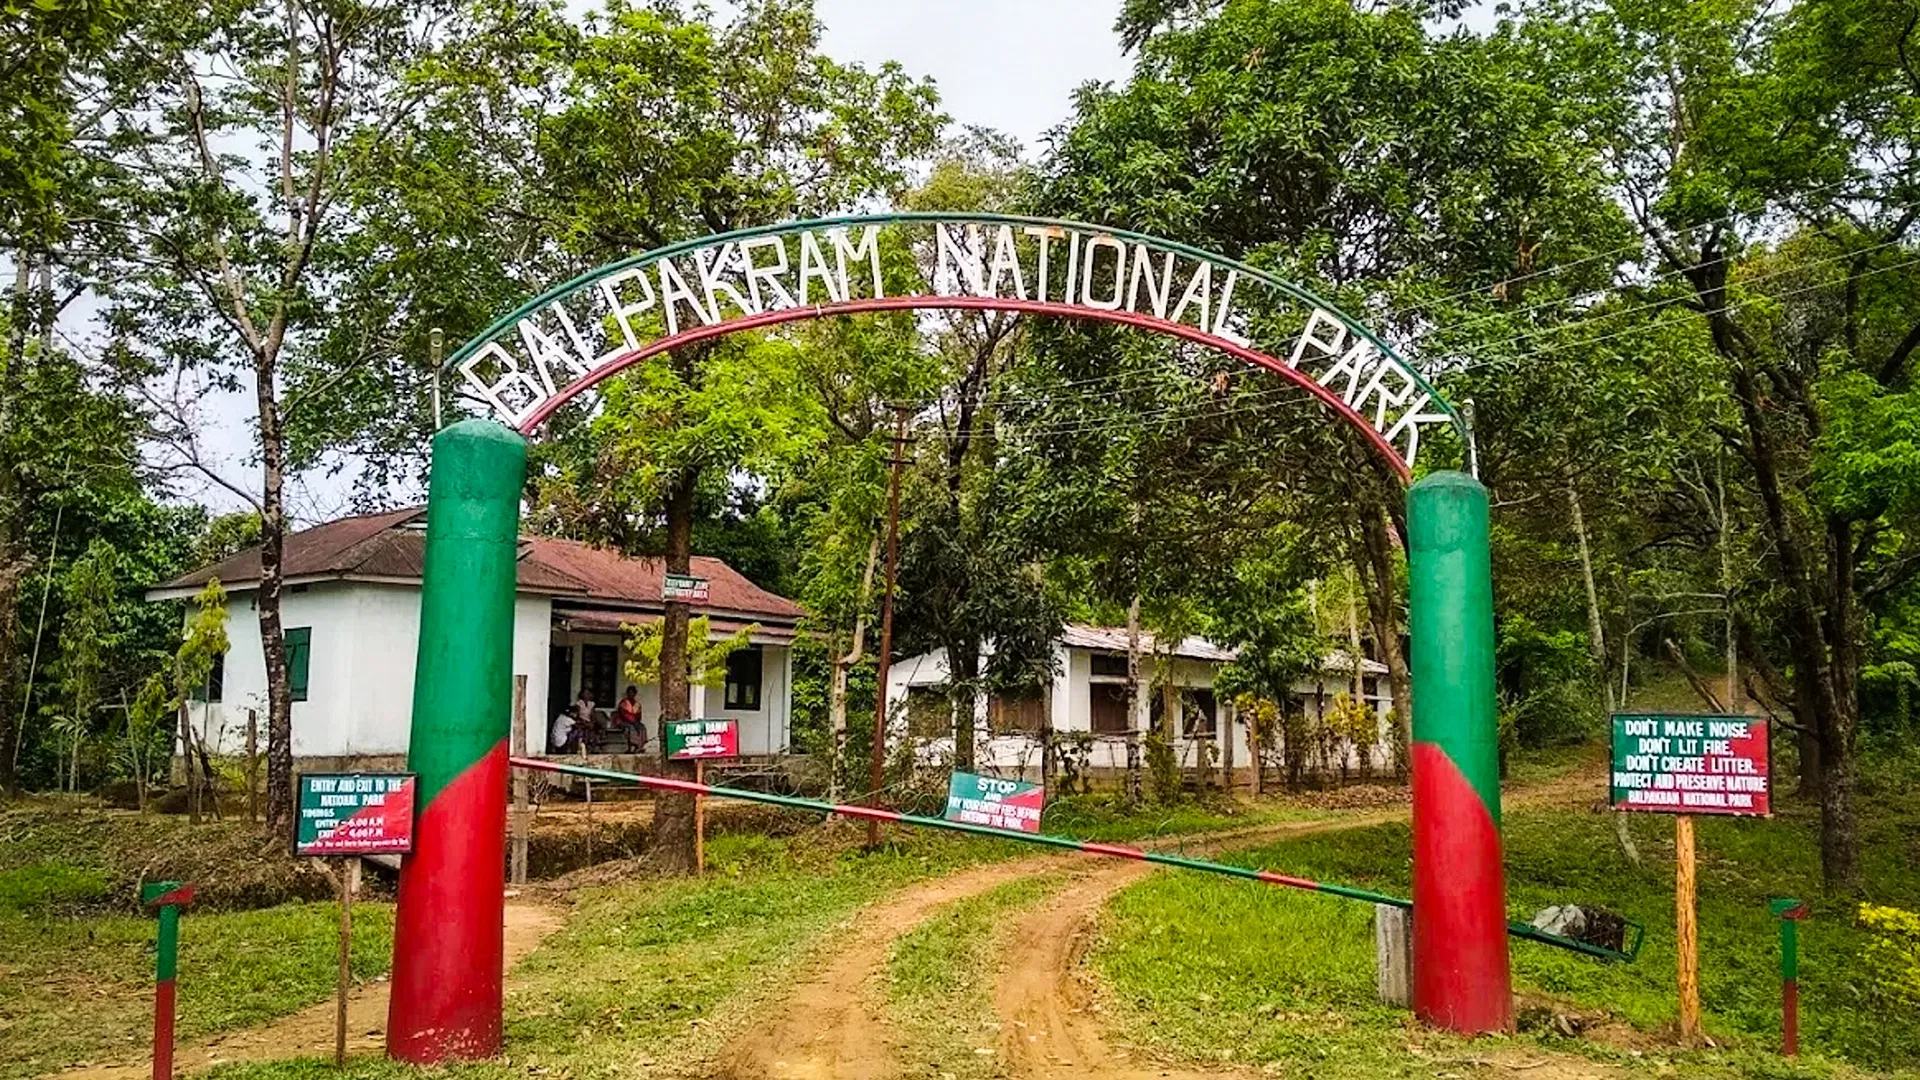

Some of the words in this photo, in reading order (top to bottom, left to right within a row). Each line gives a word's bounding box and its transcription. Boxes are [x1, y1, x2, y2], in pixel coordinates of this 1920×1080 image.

[458, 225, 883, 428] BALPAKRAM
[936, 222, 1252, 347] NATIONAL
[1288, 308, 1452, 468] PARK
[1625, 719, 1658, 736] DON'T
[1664, 721, 1704, 737] MAKE
[1638, 737, 1671, 754] DON'T
[1678, 739, 1698, 755] LIT
[1626, 754, 1659, 771] DON'T
[1661, 756, 1706, 773] CREATE
[311, 779, 337, 793] ENTRY
[337, 779, 356, 793] AND
[356, 779, 374, 793] EXIT
[375, 779, 385, 792] TO
[387, 779, 402, 792] THE
[977, 777, 1017, 793] STOP
[1613, 772, 1653, 788] PROTECT
[1654, 774, 1674, 789] AND
[1675, 774, 1725, 791] PRESERVE
[1726, 776, 1767, 792] NATURE
[320, 794, 359, 807] NATIONAL
[362, 793, 386, 806] PARK
[983, 791, 1001, 802] AND
[1683, 791, 1728, 807] NATIONAL
[1728, 793, 1753, 808] PARK
[302, 808, 335, 818] TIMINGS
[990, 814, 1004, 828] THE
[318, 829, 335, 839] EXIT
